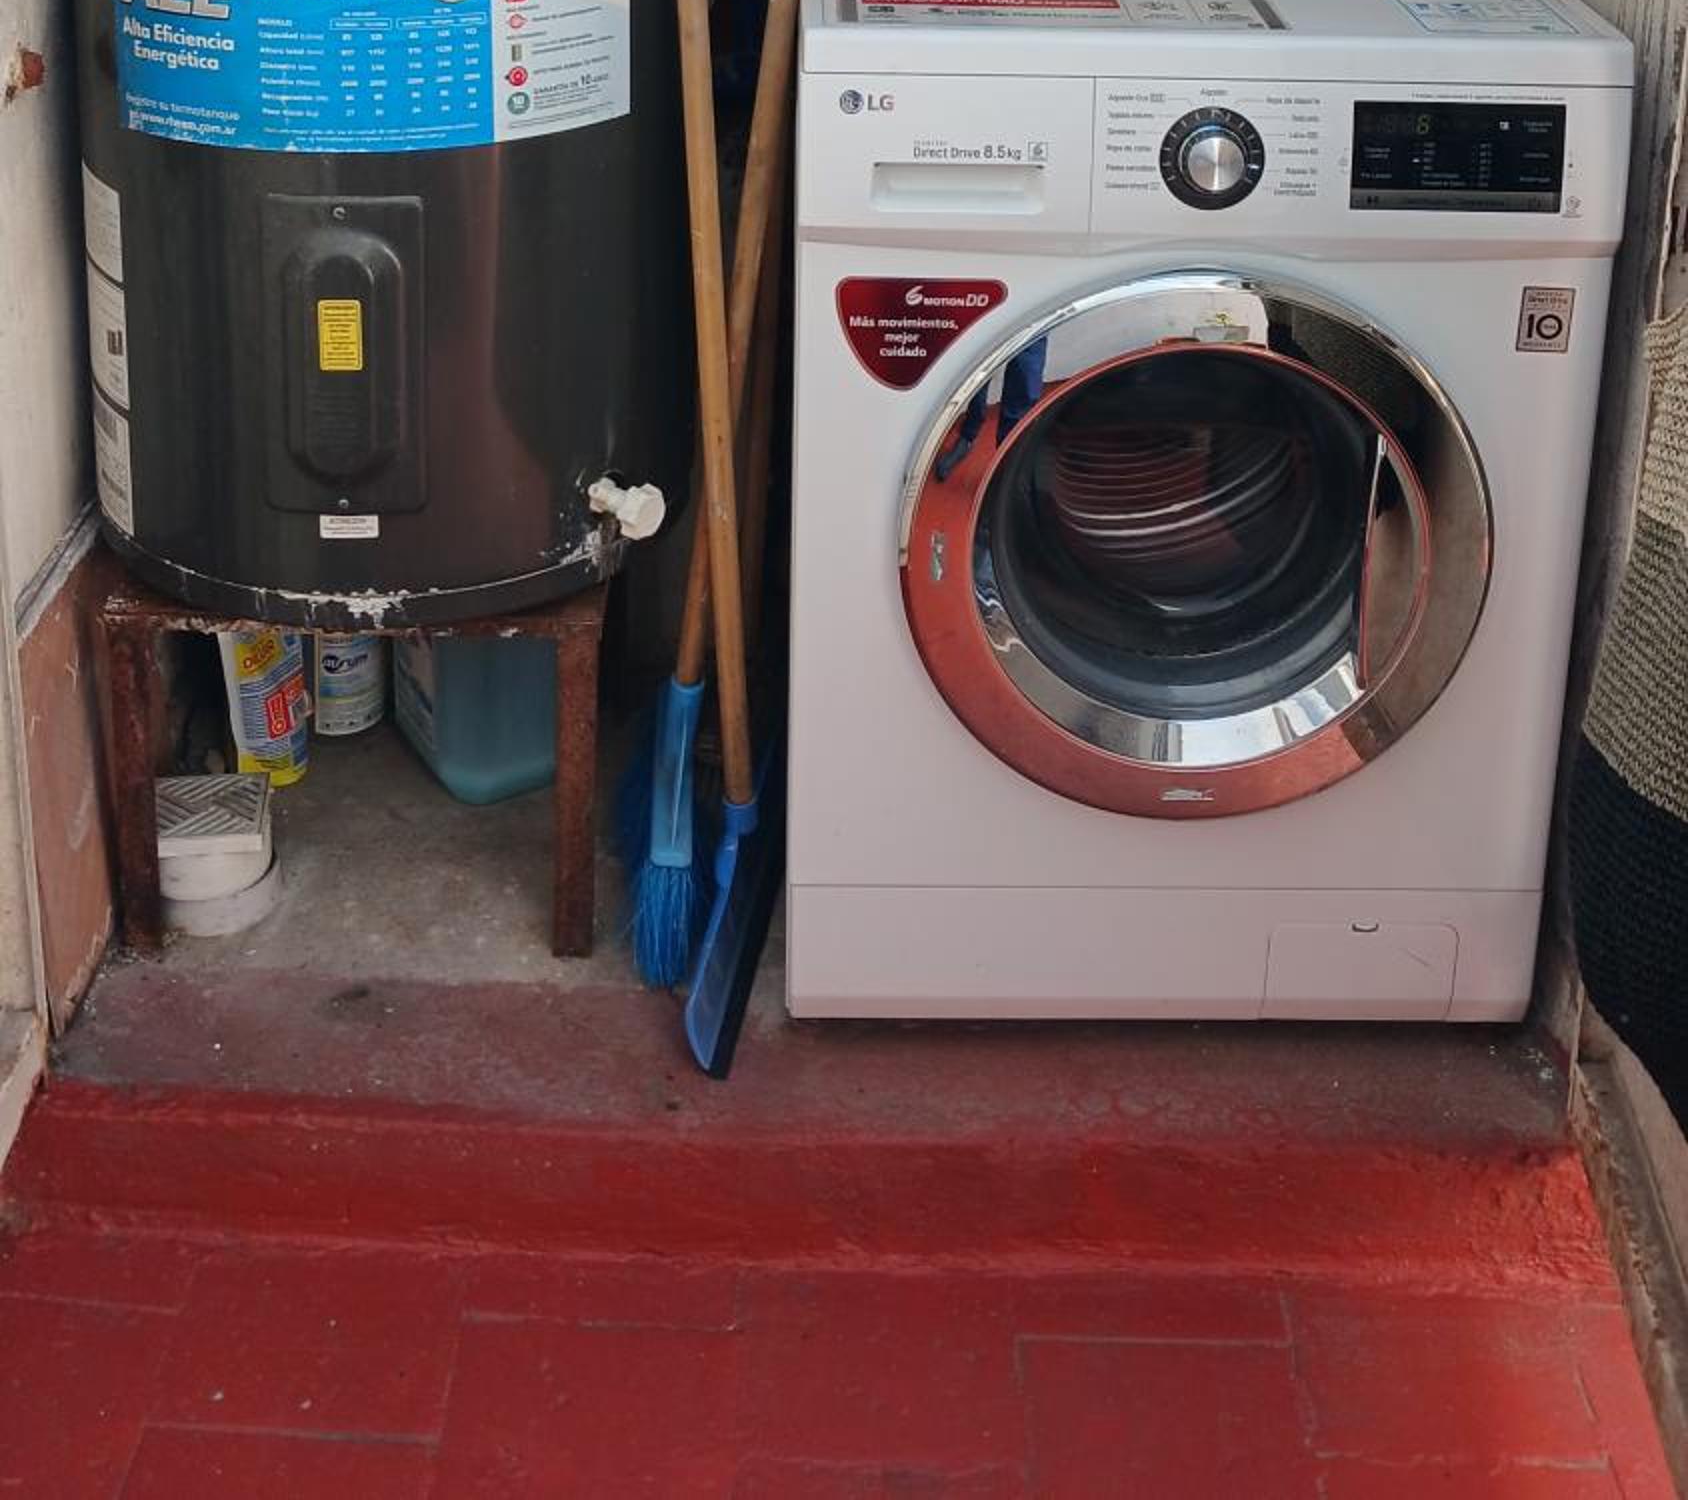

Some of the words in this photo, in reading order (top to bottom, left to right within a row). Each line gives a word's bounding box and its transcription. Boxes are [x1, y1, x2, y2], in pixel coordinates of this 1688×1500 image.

[122, 16, 151, 39] Alta
[154, 23, 235, 51] Eficiencia
[134, 40, 220, 70] Energética
[867, 94, 896, 111] LG
[912, 146, 948, 160] Direct
[950, 146, 981, 160] Drive
[849, 315, 875, 328] Más
[877, 316, 959, 330] movimientos,
[884, 332, 920, 345] mejor
[879, 345, 927, 357] cuidado
